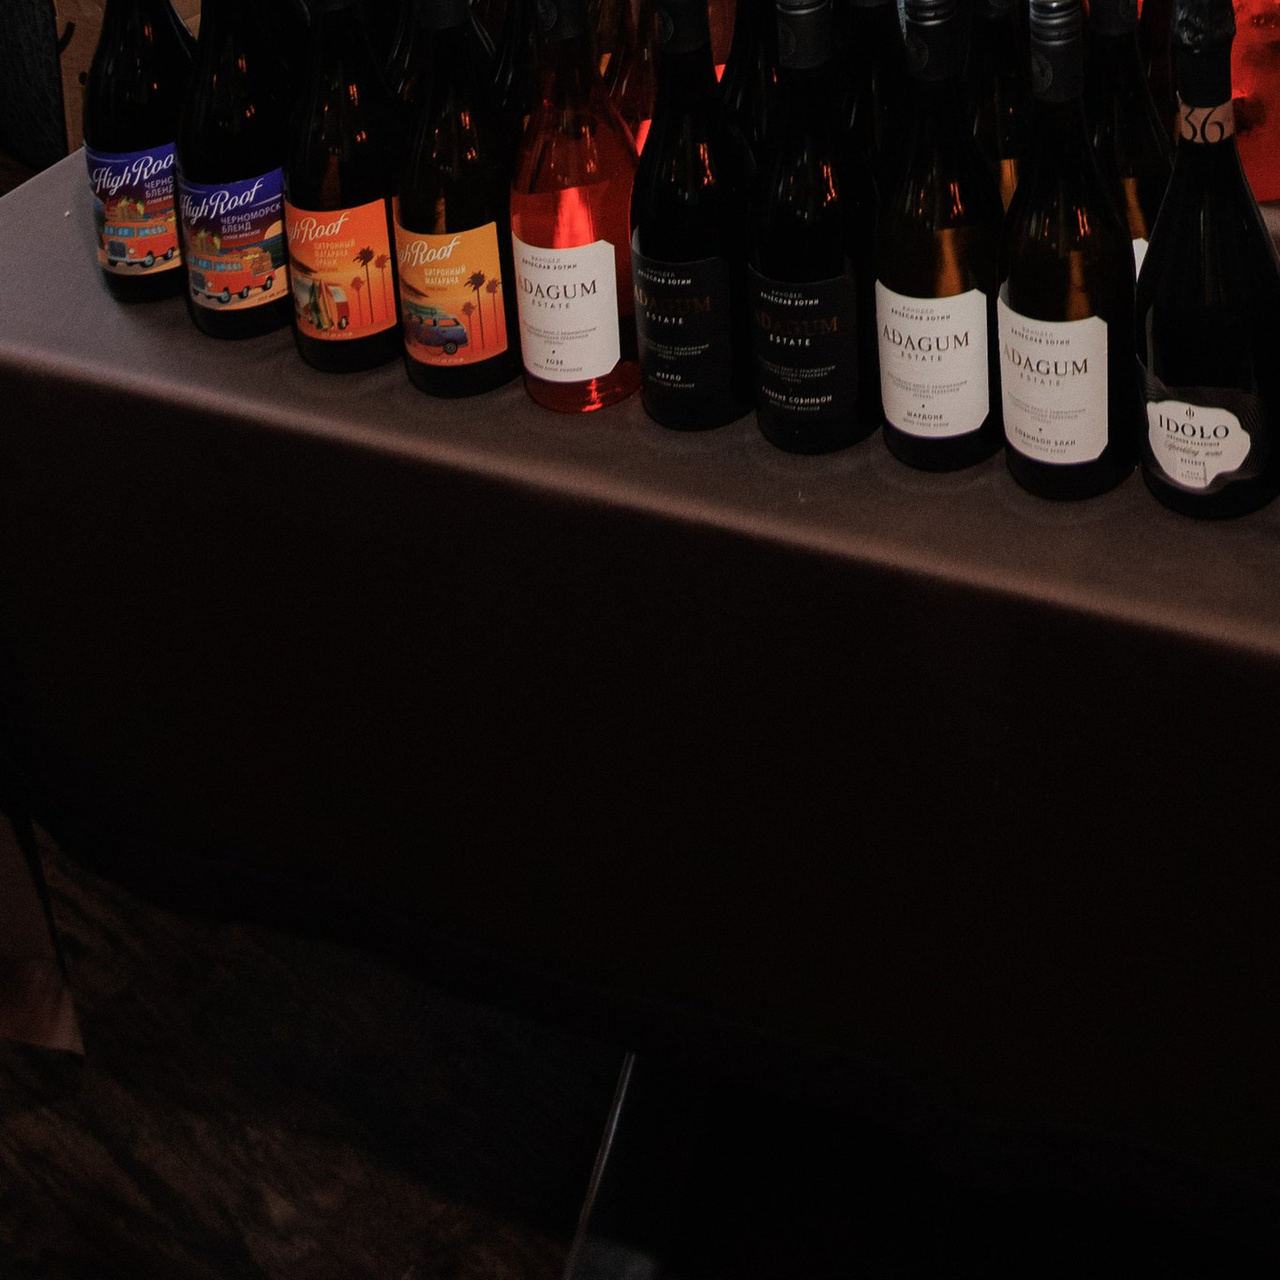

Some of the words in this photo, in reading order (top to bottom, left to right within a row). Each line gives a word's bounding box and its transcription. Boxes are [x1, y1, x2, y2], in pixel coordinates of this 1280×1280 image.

[93, 166, 132, 196] High
[132, 153, 174, 187] Roo
[209, 177, 265, 219] Roof
[220, 202, 282, 224] ЧЕРНОМОРСК
[221, 221, 252, 235] БЛЕНД
[300, 211, 350, 244] Roof
[411, 235, 462, 267] Roof
[532, 299, 571, 309] ESTATE
[769, 333, 811, 347] ESTATE
[883, 324, 969, 352] ADAGUM
[901, 350, 942, 361] ESTATE
[1003, 343, 1088, 377] ADAGUM
[1020, 373, 1061, 387] ESTATE
[789, 394, 832, 404] СОВИНЬОН
[906, 411, 943, 420] ШАРДОНЕ
[1159, 414, 1230, 439] IDOLO
